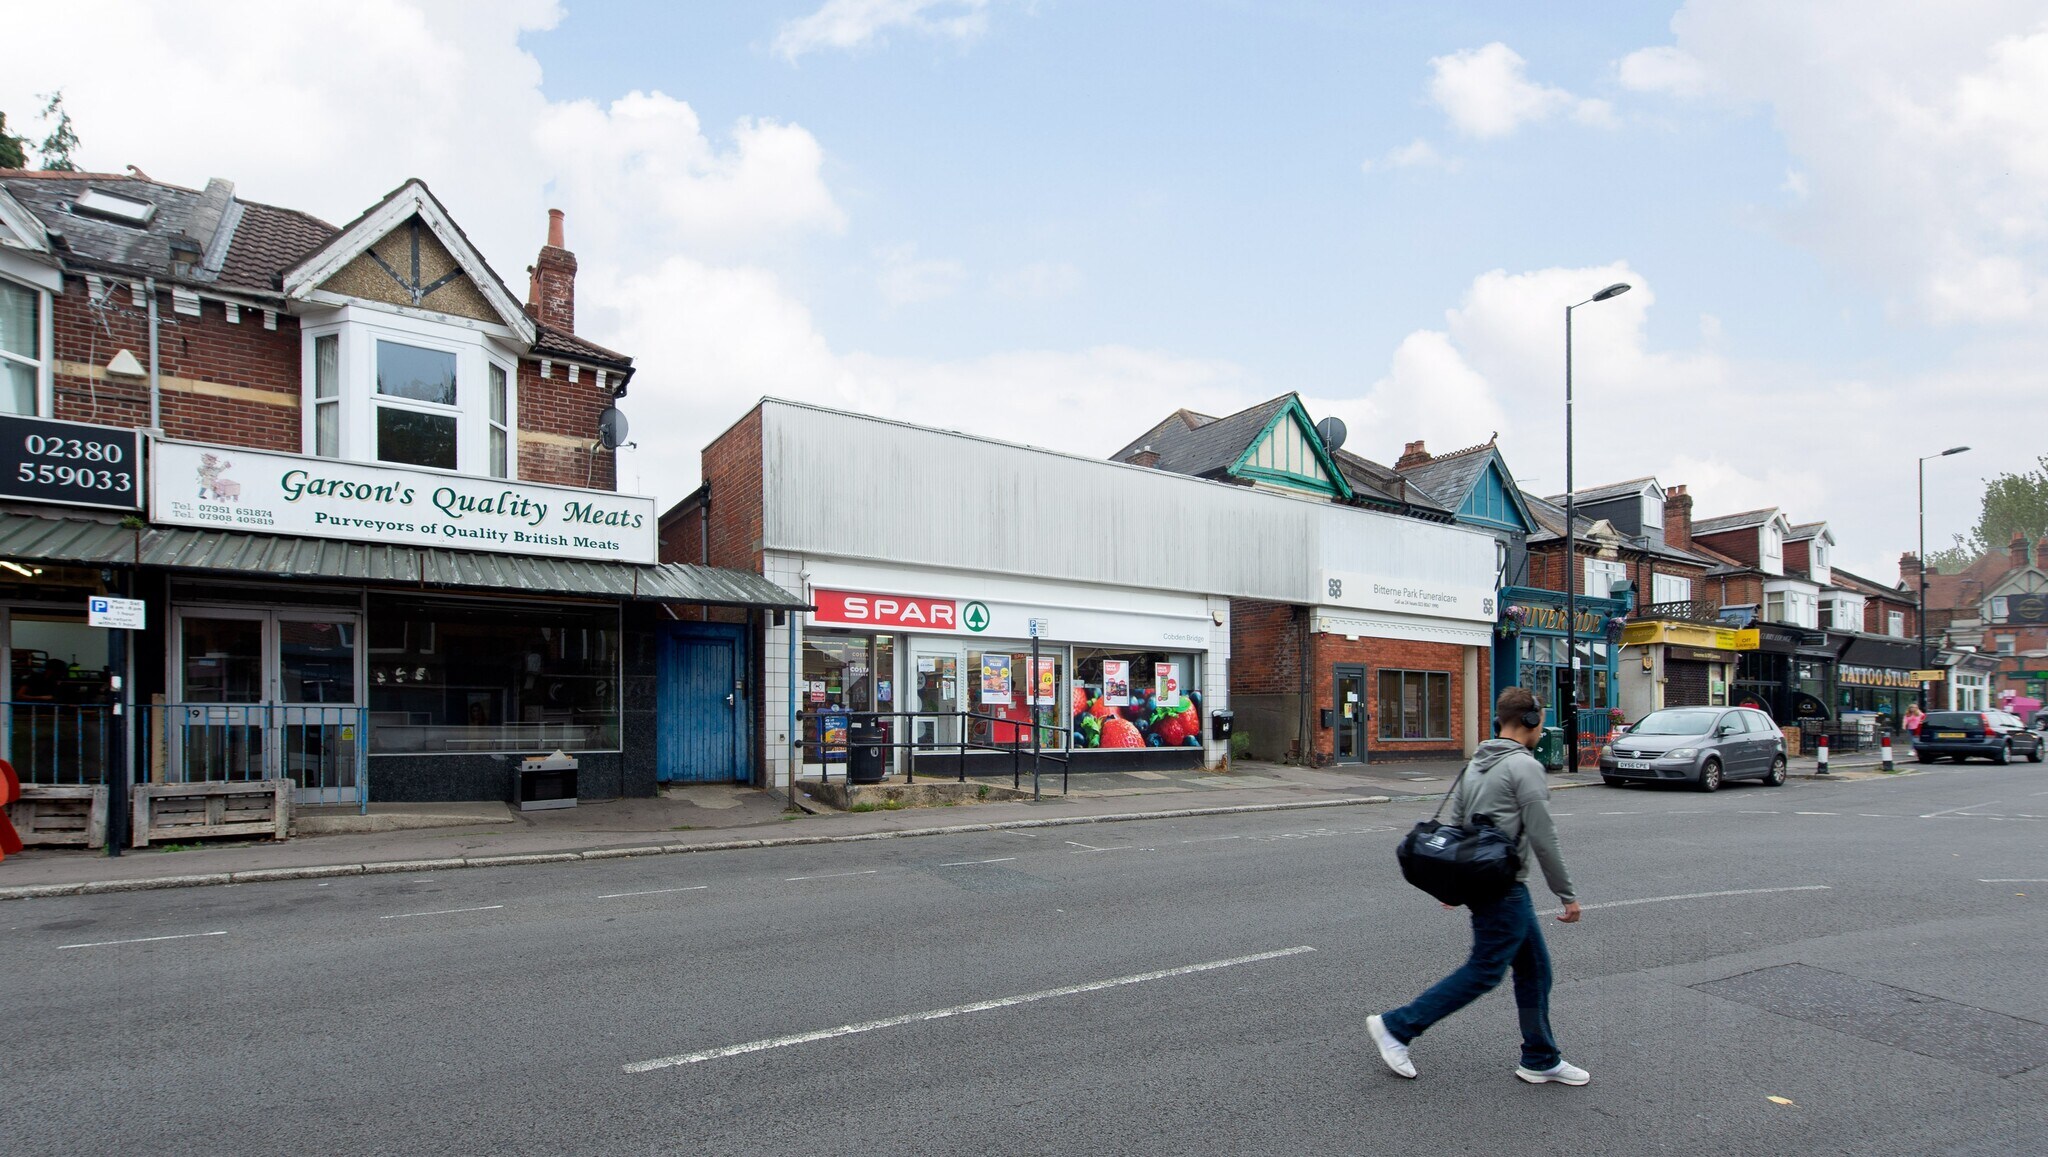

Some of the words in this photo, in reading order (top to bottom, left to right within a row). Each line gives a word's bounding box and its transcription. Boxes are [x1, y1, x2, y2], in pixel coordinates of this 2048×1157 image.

[24, 434, 123, 464] 02380
[17, 462, 131, 492] 559033
[172, 501, 194, 511] Tel.
[199, 504, 230, 514] 07951
[236, 508, 273, 518] 651874
[281, 469, 417, 505] Garson's
[432, 487, 548, 527] Quality
[562, 501, 643, 529] Meats
[173, 510, 194, 519] Tel.
[199, 512, 232, 522] 07908
[236, 516, 275, 526] 405819
[314, 511, 415, 532] Purveyors
[420, 523, 438, 534] of
[442, 524, 508, 543] Quality
[513, 530, 568, 546] British
[573, 536, 620, 550] Meats
[1374, 584, 1402, 596] Bitterne
[1403, 588, 1418, 598] Park
[1420, 590, 1458, 603] Funeralcare
[844, 598, 953, 624] SPAR
[1521, 606, 1602, 633] RIVERIDE
[1187, 634, 1204, 643] Bridge
[1839, 664, 1883, 686] TATTOO
